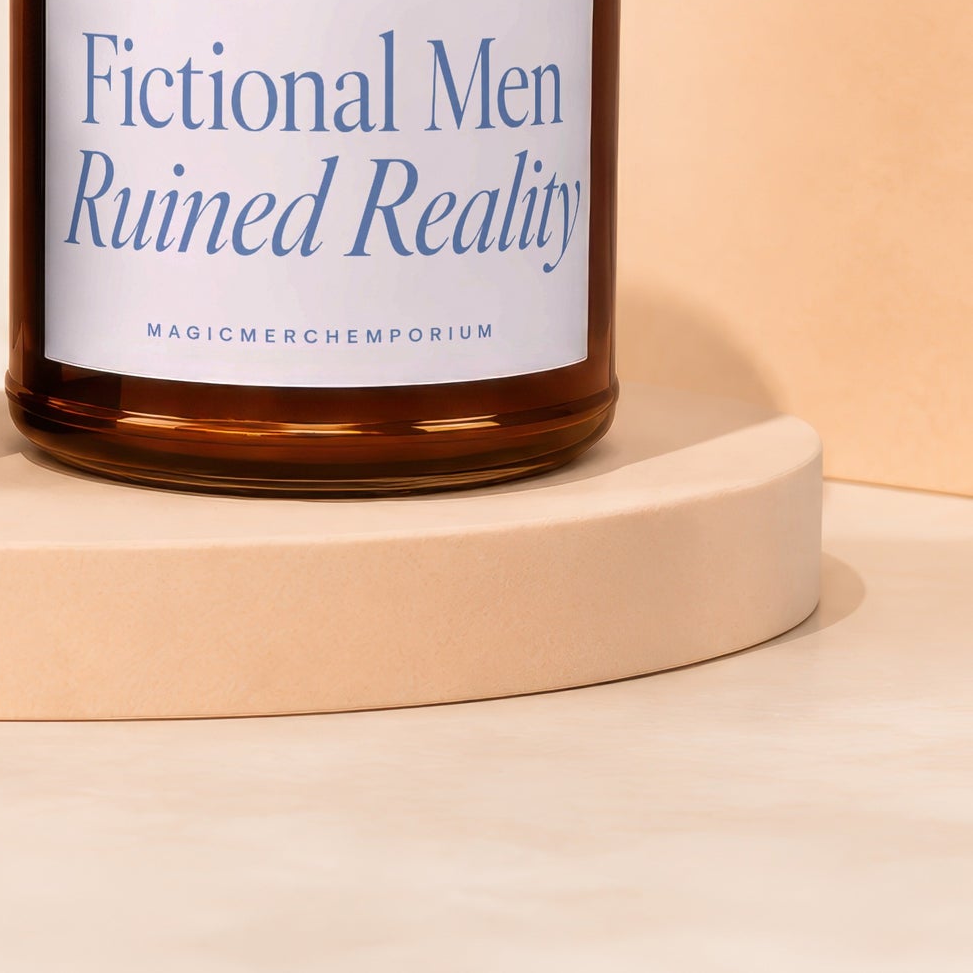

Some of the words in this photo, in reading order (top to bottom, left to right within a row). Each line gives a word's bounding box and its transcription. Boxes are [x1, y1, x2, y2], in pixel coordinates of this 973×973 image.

[81, 30, 398, 134] Fictional
[426, 37, 564, 133] Men
[63, 148, 339, 258] Ruined
[344, 149, 582, 274] Reality
[146, 322, 494, 345] MAGICMERCHEMPORIUM
